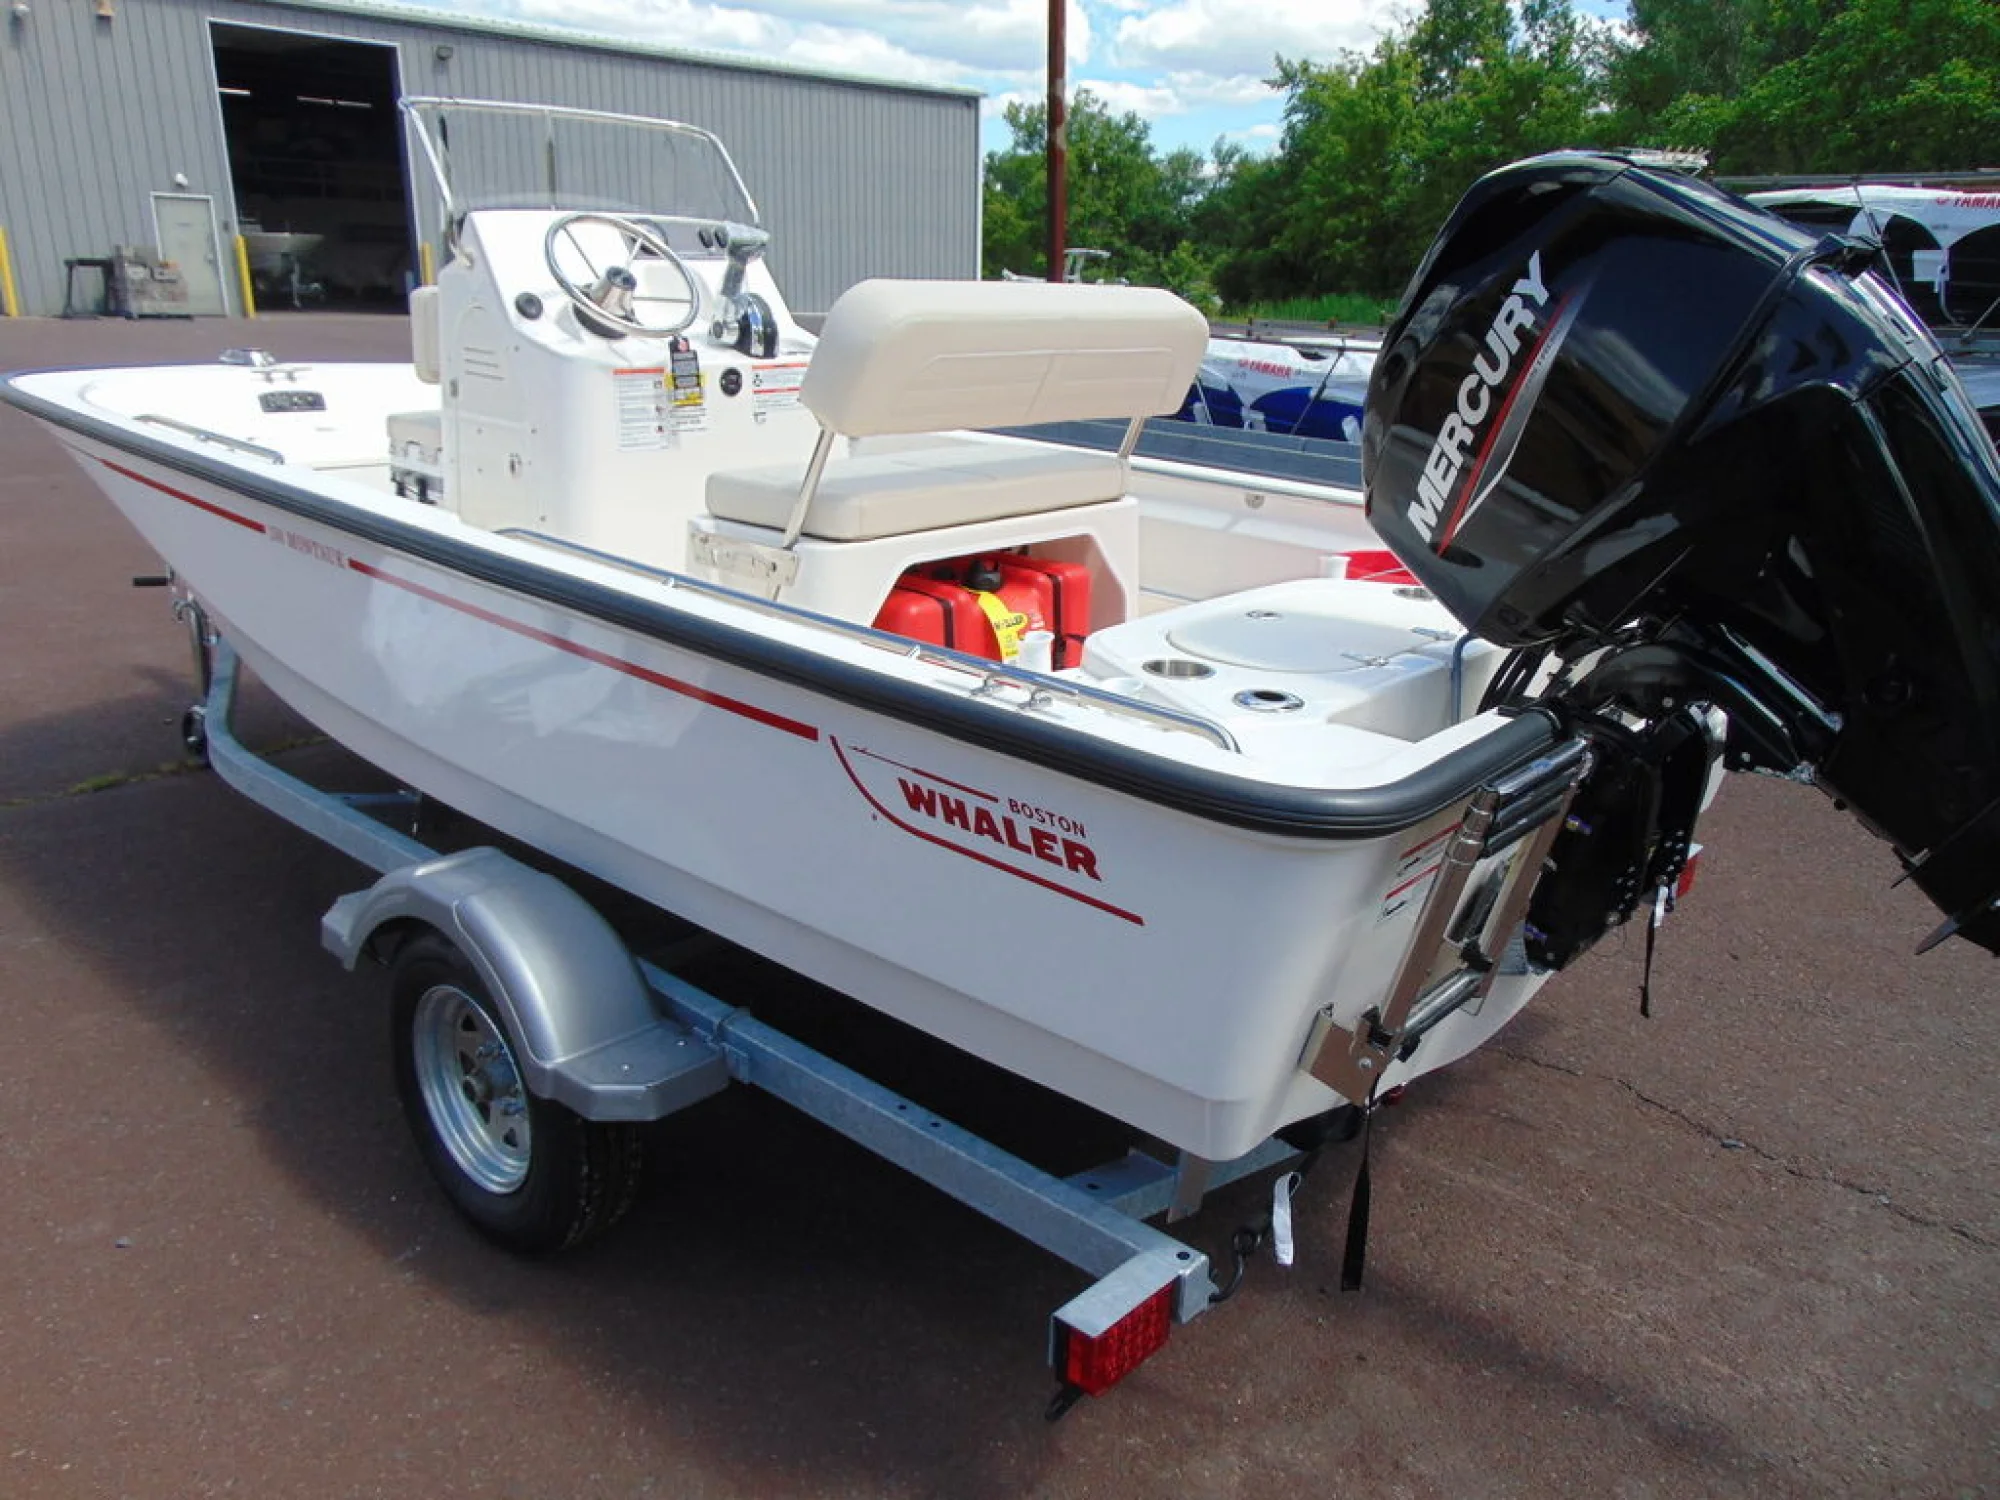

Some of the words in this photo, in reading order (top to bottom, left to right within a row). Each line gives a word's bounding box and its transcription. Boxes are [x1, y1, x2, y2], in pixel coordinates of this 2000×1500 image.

[1249, 360, 1291, 379] YAMAHA
[1407, 249, 1549, 543] MERCURY
[897, 776, 1102, 882] WHALER
[1007, 797, 1086, 839] BOSTON
